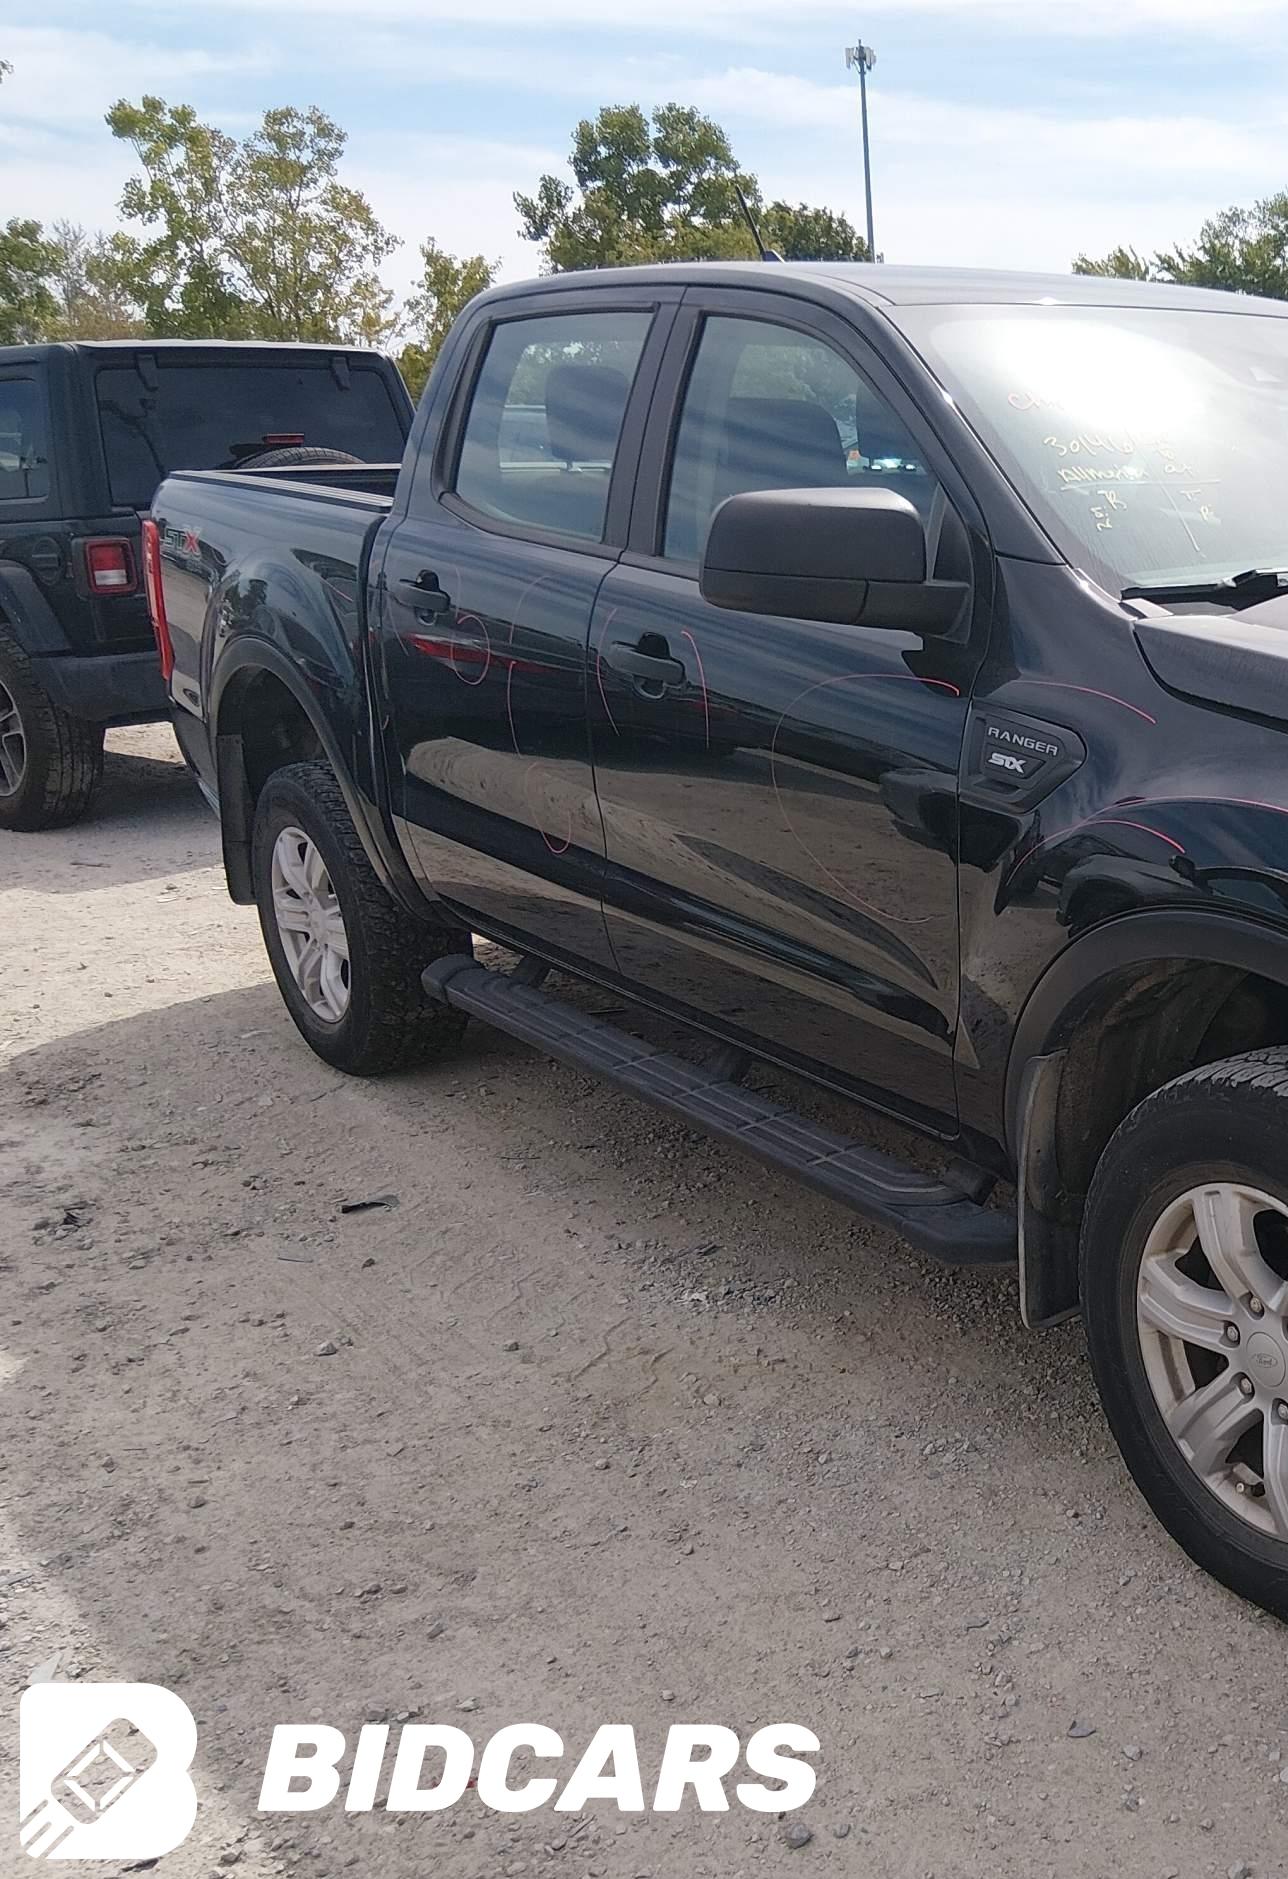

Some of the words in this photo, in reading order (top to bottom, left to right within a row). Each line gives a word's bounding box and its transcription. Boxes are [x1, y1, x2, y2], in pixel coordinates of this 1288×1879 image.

[160, 527, 202, 558] STX
[987, 726, 1059, 757] RANGER
[987, 751, 1027, 774] STX
